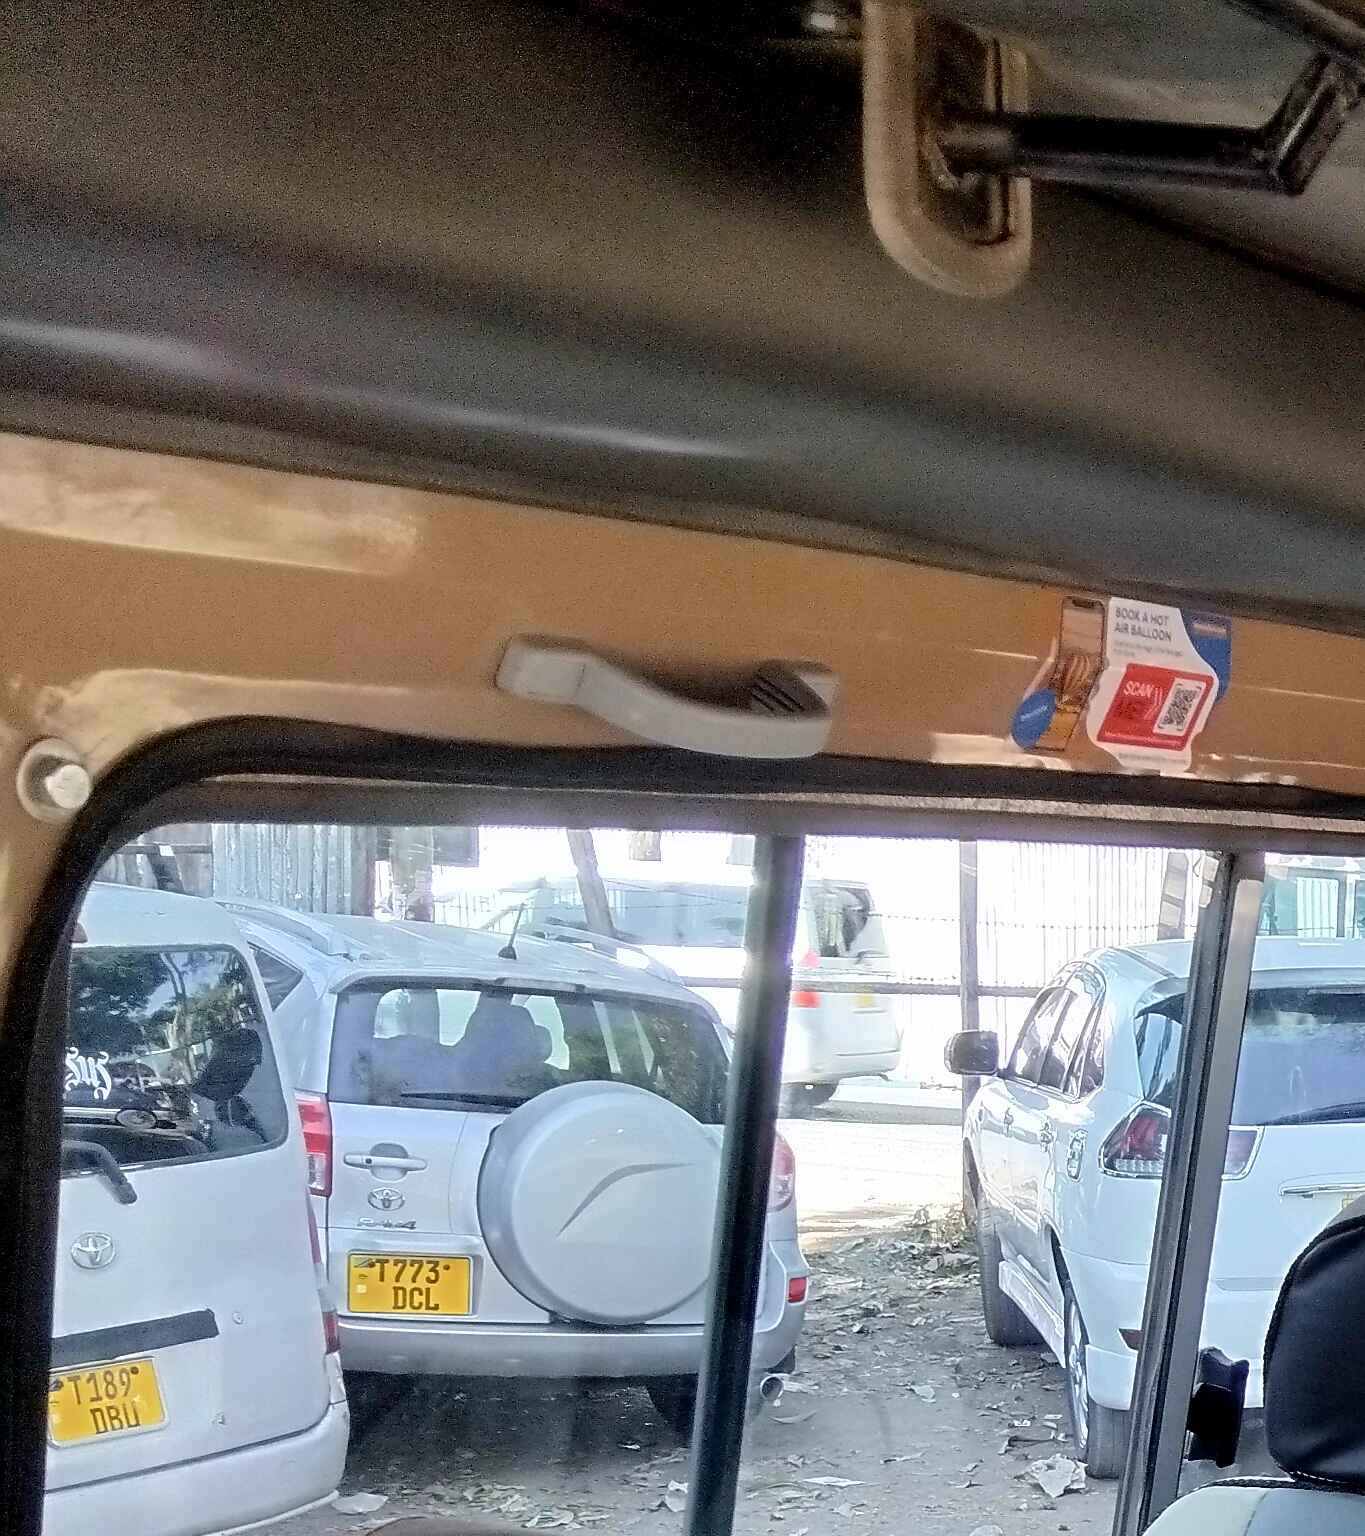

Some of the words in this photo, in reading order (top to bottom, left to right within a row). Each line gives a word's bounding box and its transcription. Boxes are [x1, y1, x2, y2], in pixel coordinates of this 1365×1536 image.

[1115, 606, 1141, 622] BOOK
[1142, 612, 1148, 623] A
[1150, 613, 1169, 627] HOT
[1114, 622, 1129, 635] AIR
[1131, 625, 1172, 642] BALLOON
[1123, 681, 1155, 698] SCAN
[375, 1258, 440, 1285] T773
[392, 1286, 440, 1311] DCL
[67, 1366, 132, 1405] T189
[89, 1401, 141, 1434] DBU
